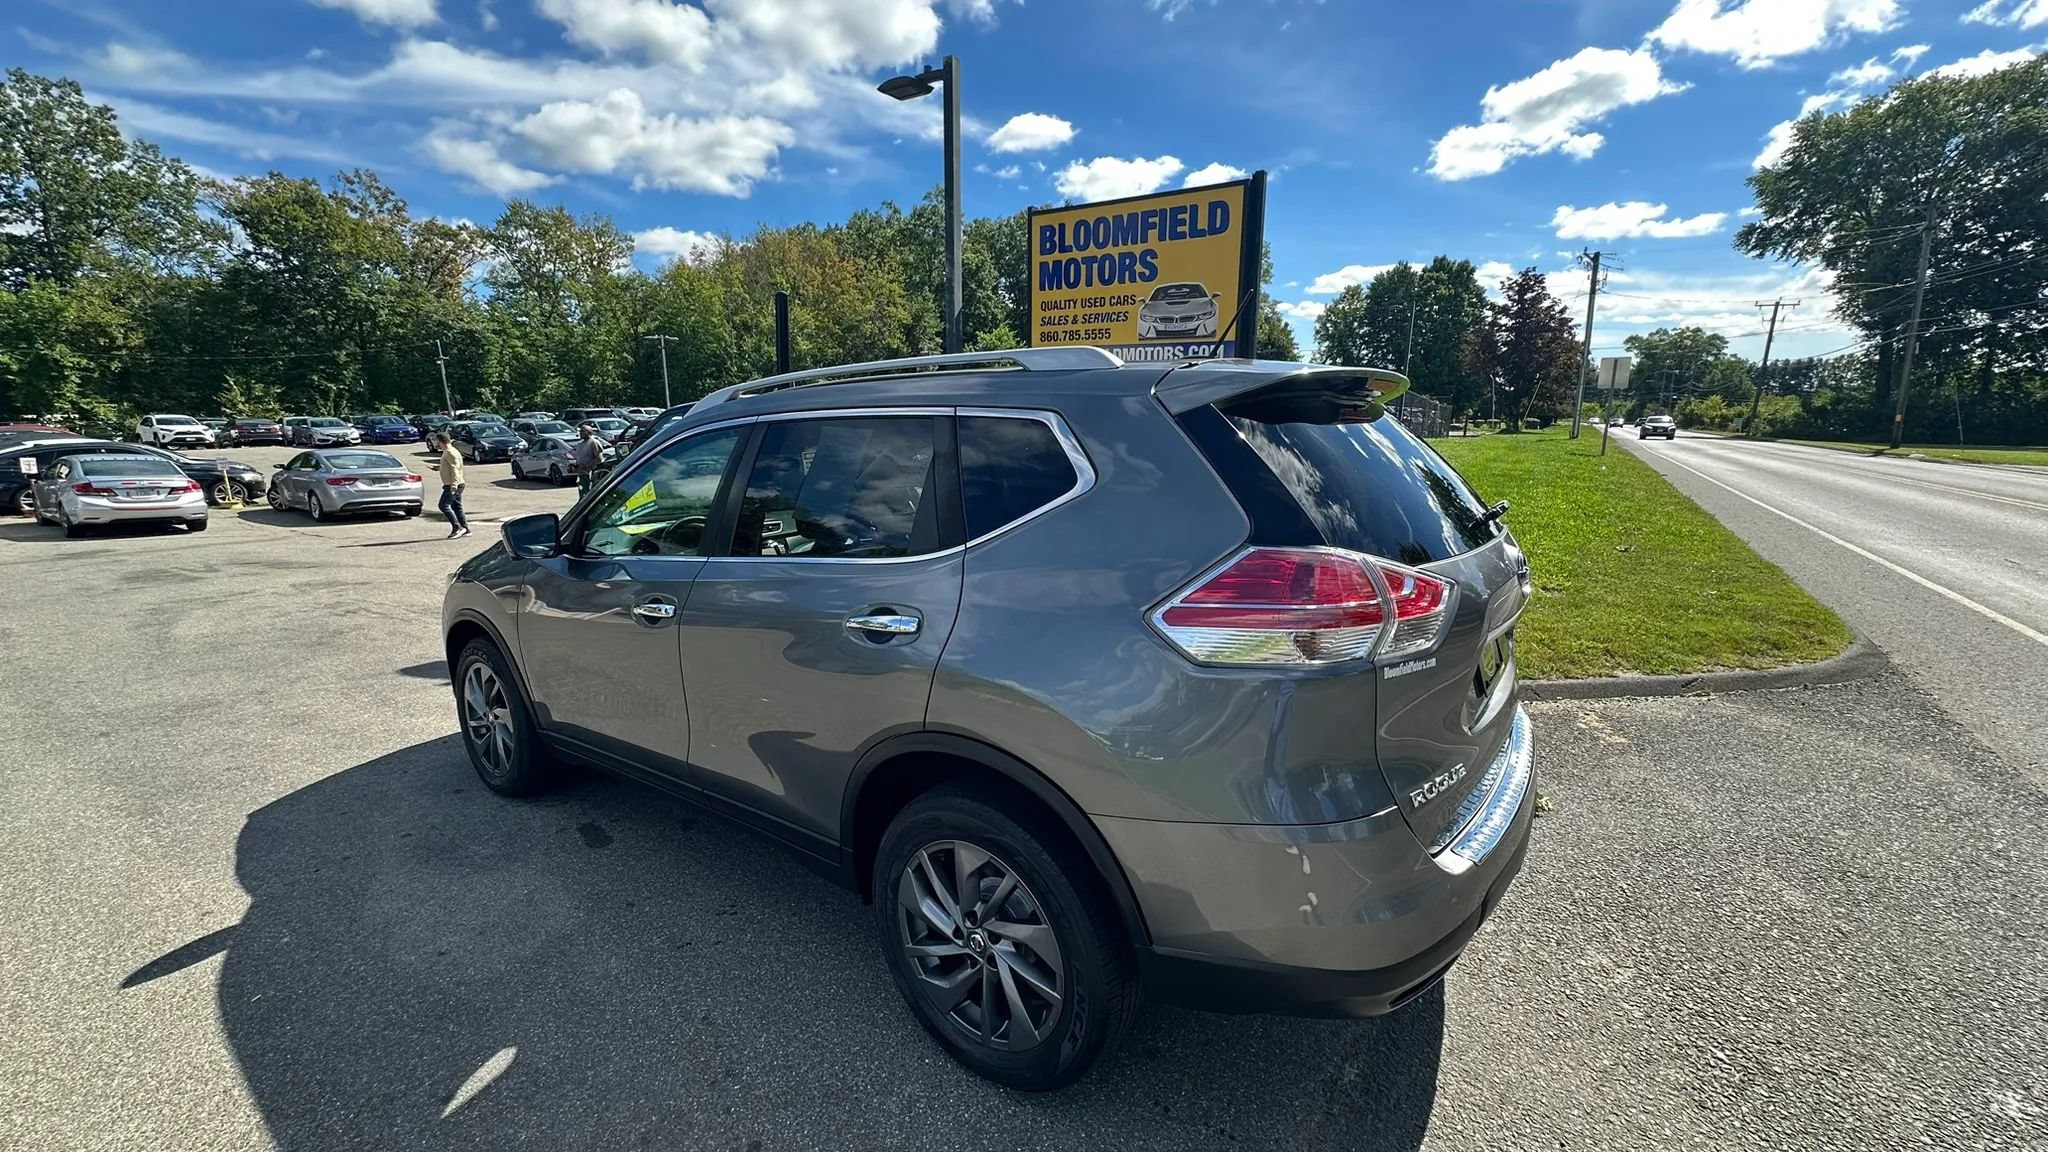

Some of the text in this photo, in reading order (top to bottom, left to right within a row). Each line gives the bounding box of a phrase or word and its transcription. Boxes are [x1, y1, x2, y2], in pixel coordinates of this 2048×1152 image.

[1039, 200, 1230, 256] BLOOMFIELD
[1039, 249, 1159, 292] MOTORS
[1040, 294, 1137, 312] QUALITY USED CARS
[1040, 311, 1129, 327] SALES & SERVICES
[1040, 328, 1111, 342] 860.785.5555
[1409, 763, 1467, 808] ROGUE
